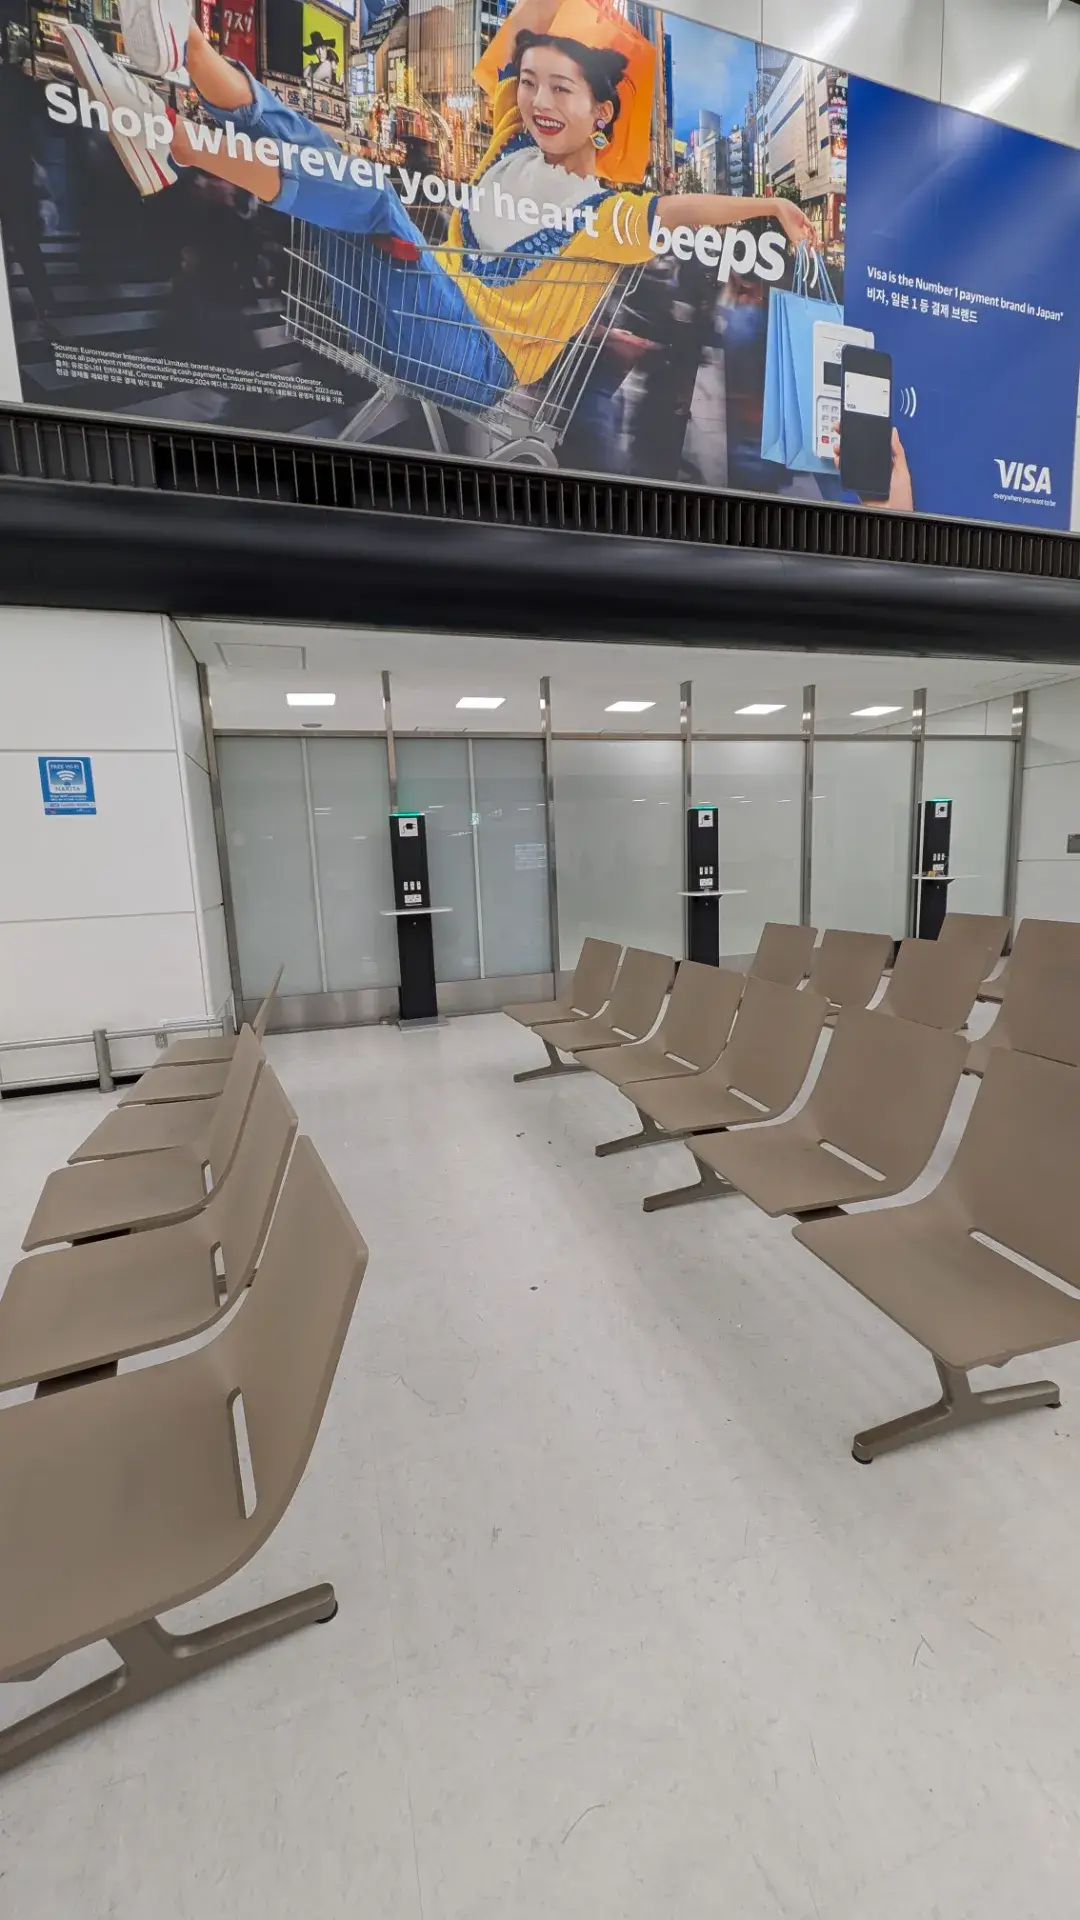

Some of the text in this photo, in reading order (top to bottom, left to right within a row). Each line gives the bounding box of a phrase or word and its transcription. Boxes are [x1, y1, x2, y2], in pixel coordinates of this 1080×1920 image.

[45, 83, 787, 282] Shop wherever your heart beeps
[867, 265, 887, 281] Visa
[889, 270, 896, 283] is
[898, 273, 914, 287] the
[915, 277, 953, 296] Number
[954, 287, 958, 298] 1
[959, 290, 999, 307] payment
[1000, 297, 1026, 313] brand
[1027, 304, 1035, 315] in
[867, 287, 978, 323] 비자, 일본 1 등 결제 브랜드
[55, 352, 76, 360] across
[86, 356, 115, 365] payment
[116, 360, 146, 369] methods
[146, 365, 177, 375] excluding
[222, 374, 253, 383] Consumer
[254, 378, 277, 387] Finance
[315, 386, 329, 394] 2023
[80, 347, 122, 358] Euromonitor
[123, 353, 163, 364] International
[190, 362, 209, 370] brand
[209, 365, 226, 373] share
[235, 368, 254, 376] Global
[270, 373, 294, 382] Network
[295, 377, 323, 386] Operator.
[136, 371, 169, 380] Consumer
[170, 375, 194, 384] Finance
[230, 383, 245, 391] 2023
[993, 458, 1051, 494] VISA
[993, 492, 1022, 503] everywhere
[1031, 498, 1045, 506] want
